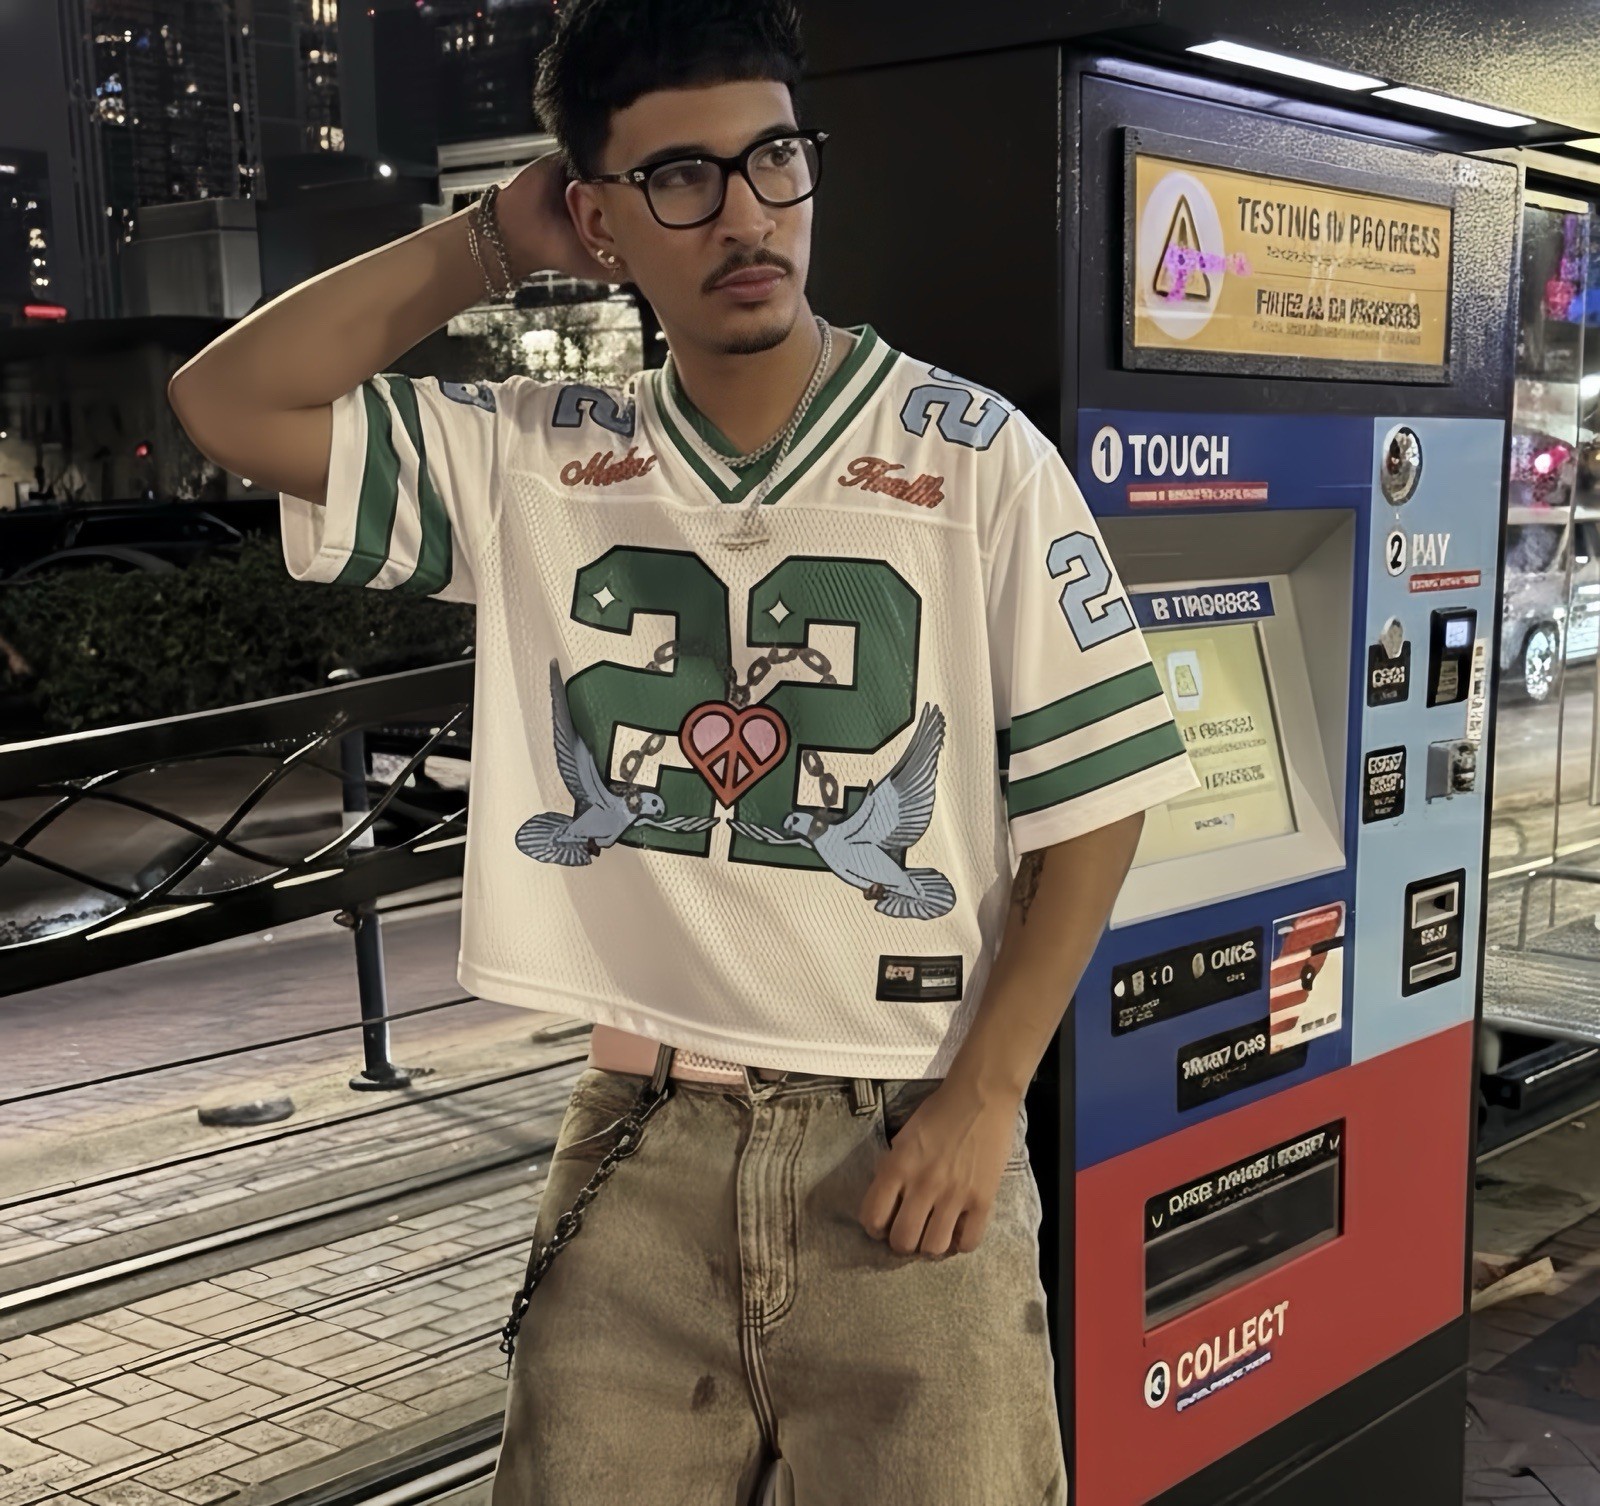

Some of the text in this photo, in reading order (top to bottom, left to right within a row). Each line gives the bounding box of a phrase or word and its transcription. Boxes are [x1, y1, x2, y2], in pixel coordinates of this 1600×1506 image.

[1128, 434, 1229, 477] TOUCH
[1046, 531, 1136, 652] 2
[1412, 533, 1451, 567] PAY
[565, 544, 922, 872] 22
[1177, 1300, 1289, 1388] COLLECT
